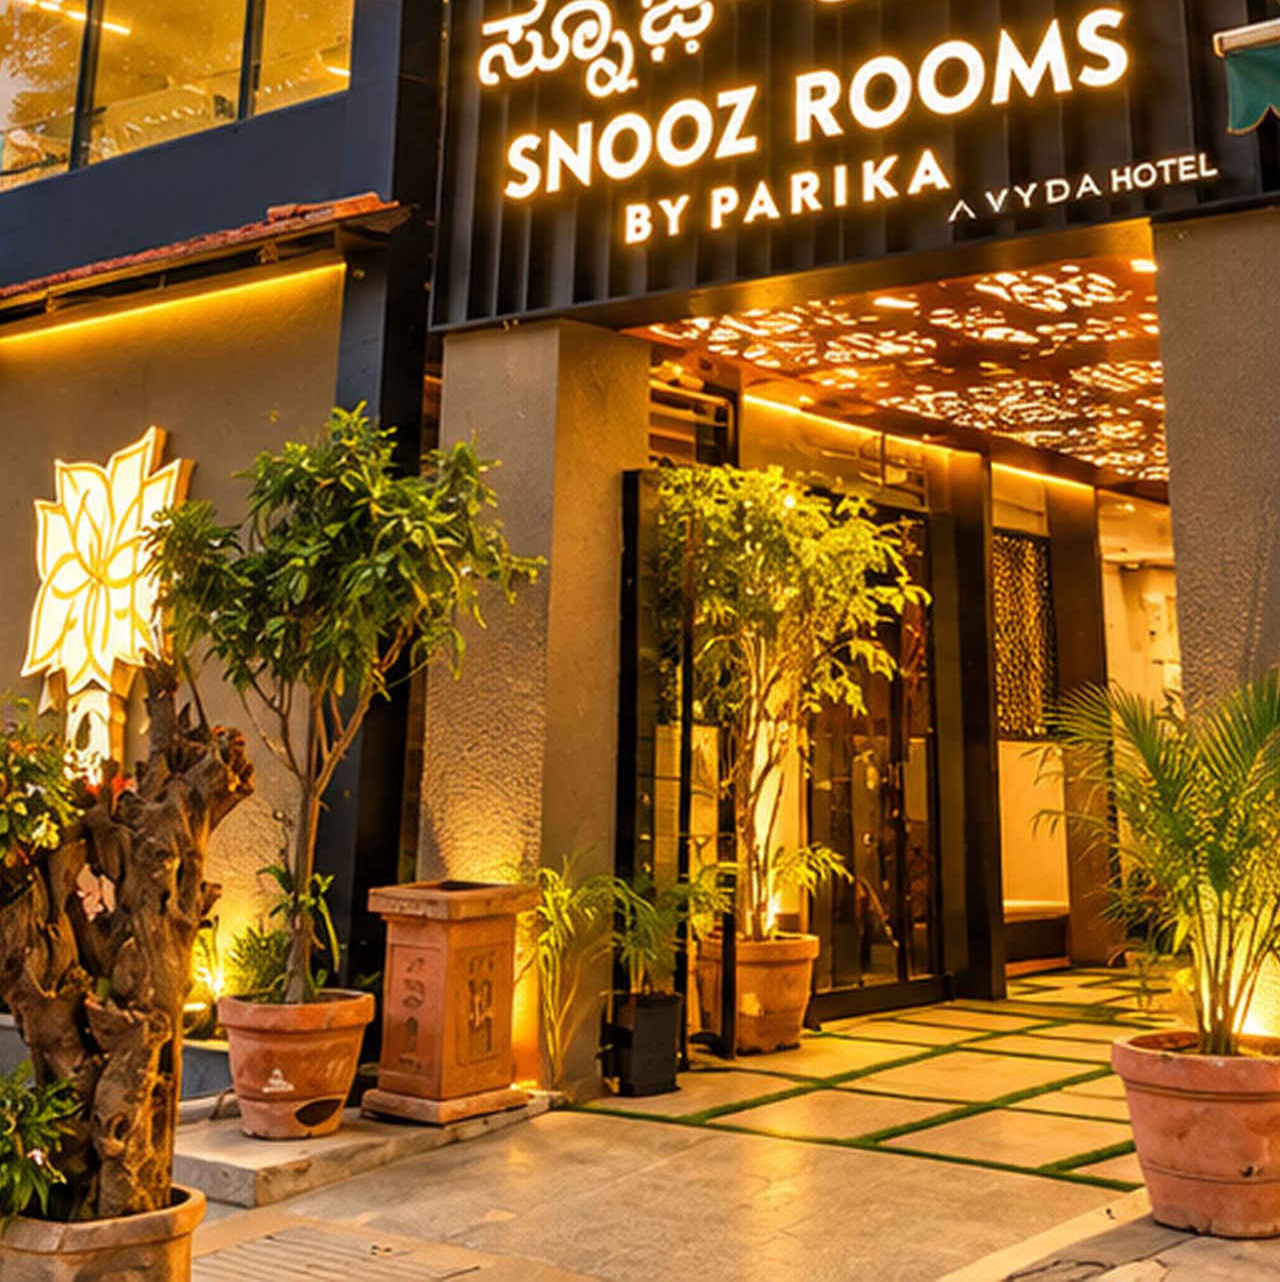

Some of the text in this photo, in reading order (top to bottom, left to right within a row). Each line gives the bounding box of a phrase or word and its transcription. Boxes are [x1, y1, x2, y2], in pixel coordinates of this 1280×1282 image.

[504, 7, 1129, 200] SNOOZ ROOMS
[624, 148, 951, 245] BY PARIKA
[984, 173, 1103, 214] VYDA
[1110, 152, 1219, 193] HOTEL
